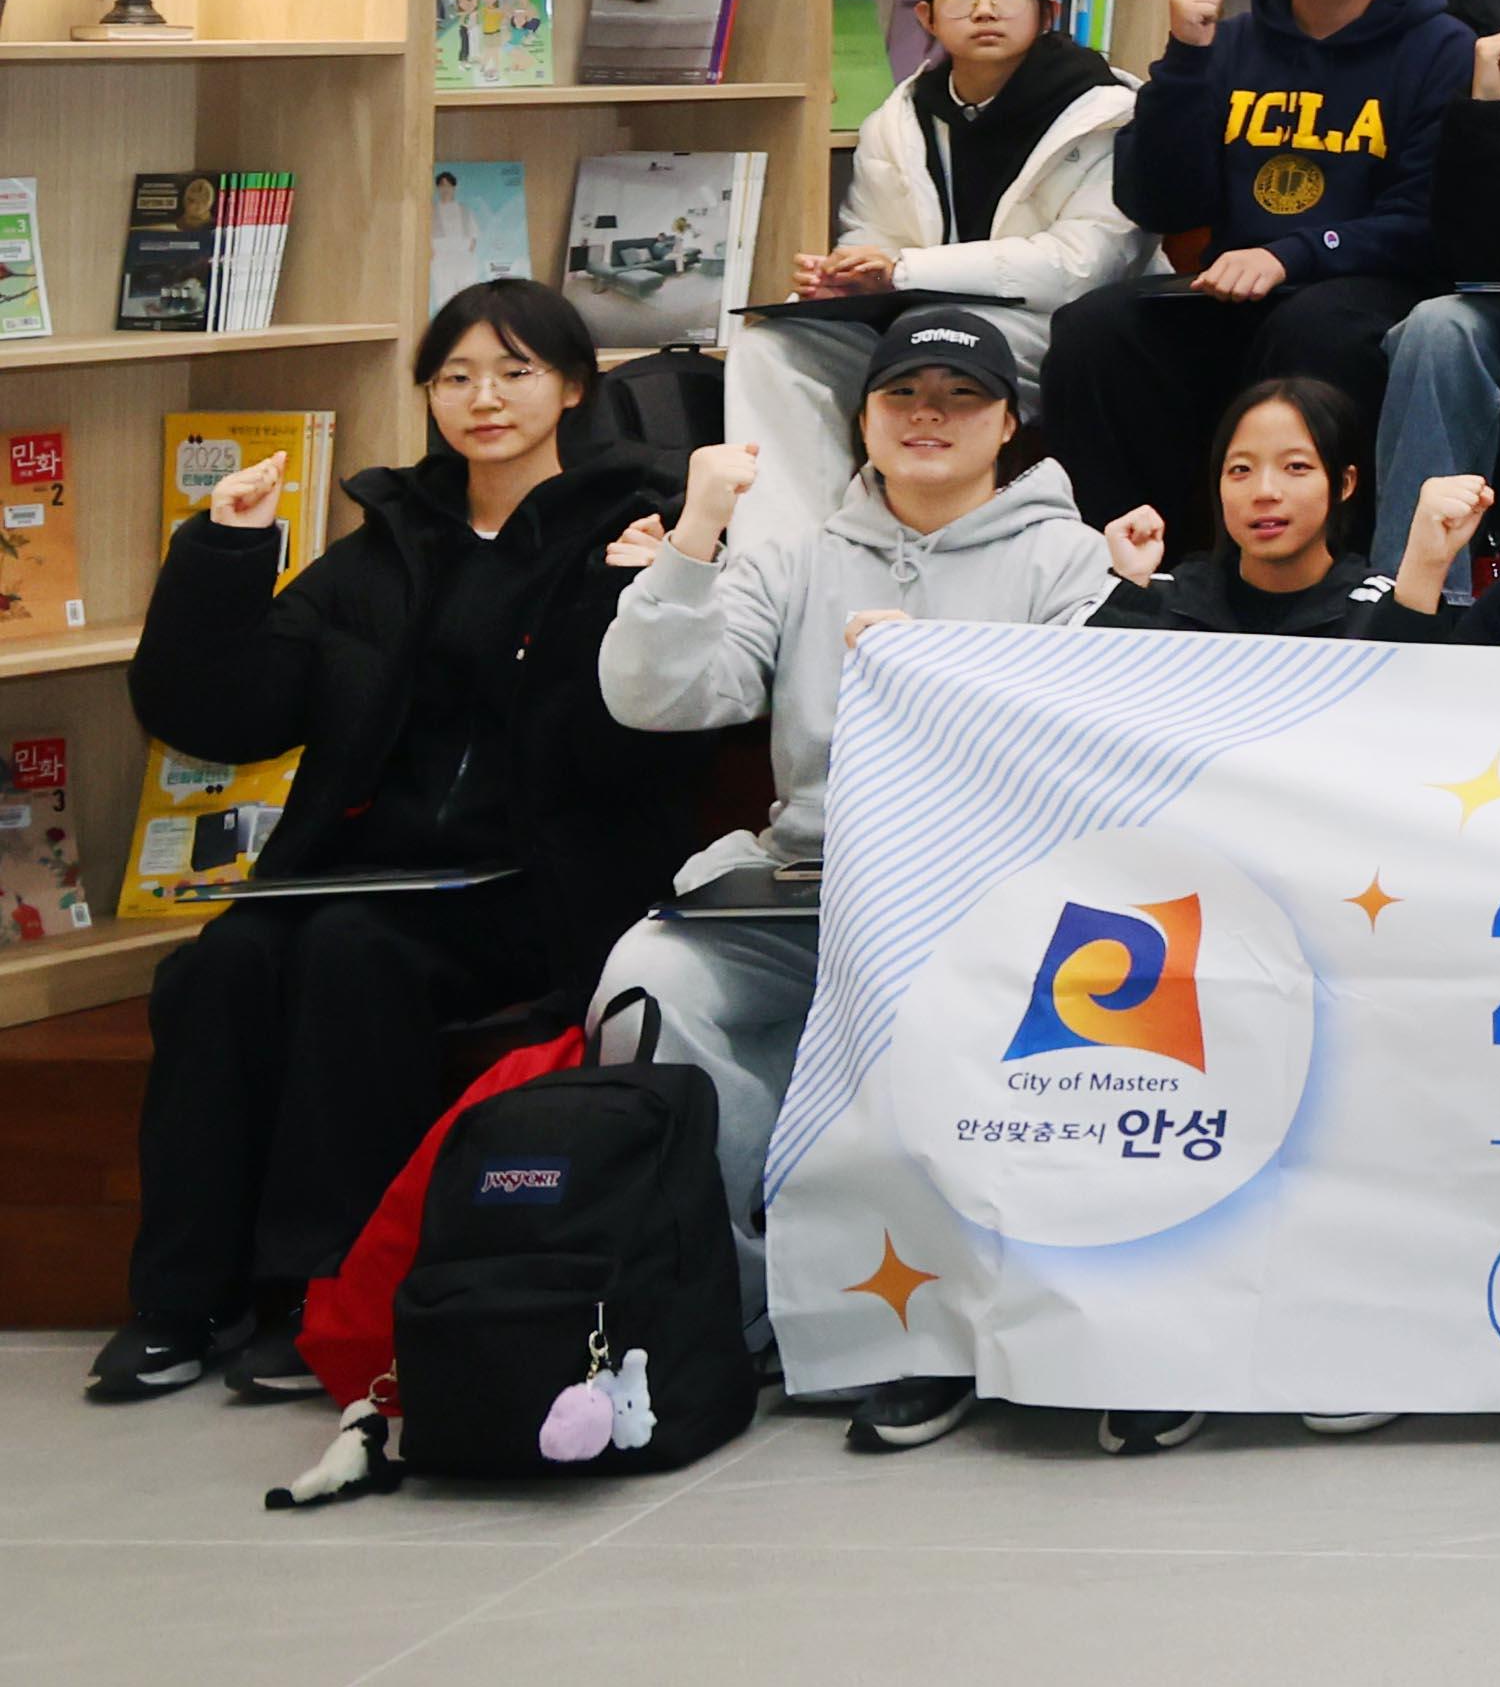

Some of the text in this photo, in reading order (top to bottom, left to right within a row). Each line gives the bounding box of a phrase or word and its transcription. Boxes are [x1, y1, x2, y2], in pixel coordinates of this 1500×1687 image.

[12, 440, 62, 477] 민화
[51, 482, 65, 506] 2
[15, 745, 64, 783] 민화
[53, 789, 65, 812] 3
[1008, 1072, 1180, 1096] City of Masters
[956, 1109, 1229, 1162] 안성맞춤도시 안성
[480, 1169, 562, 1193] JANSPORT
